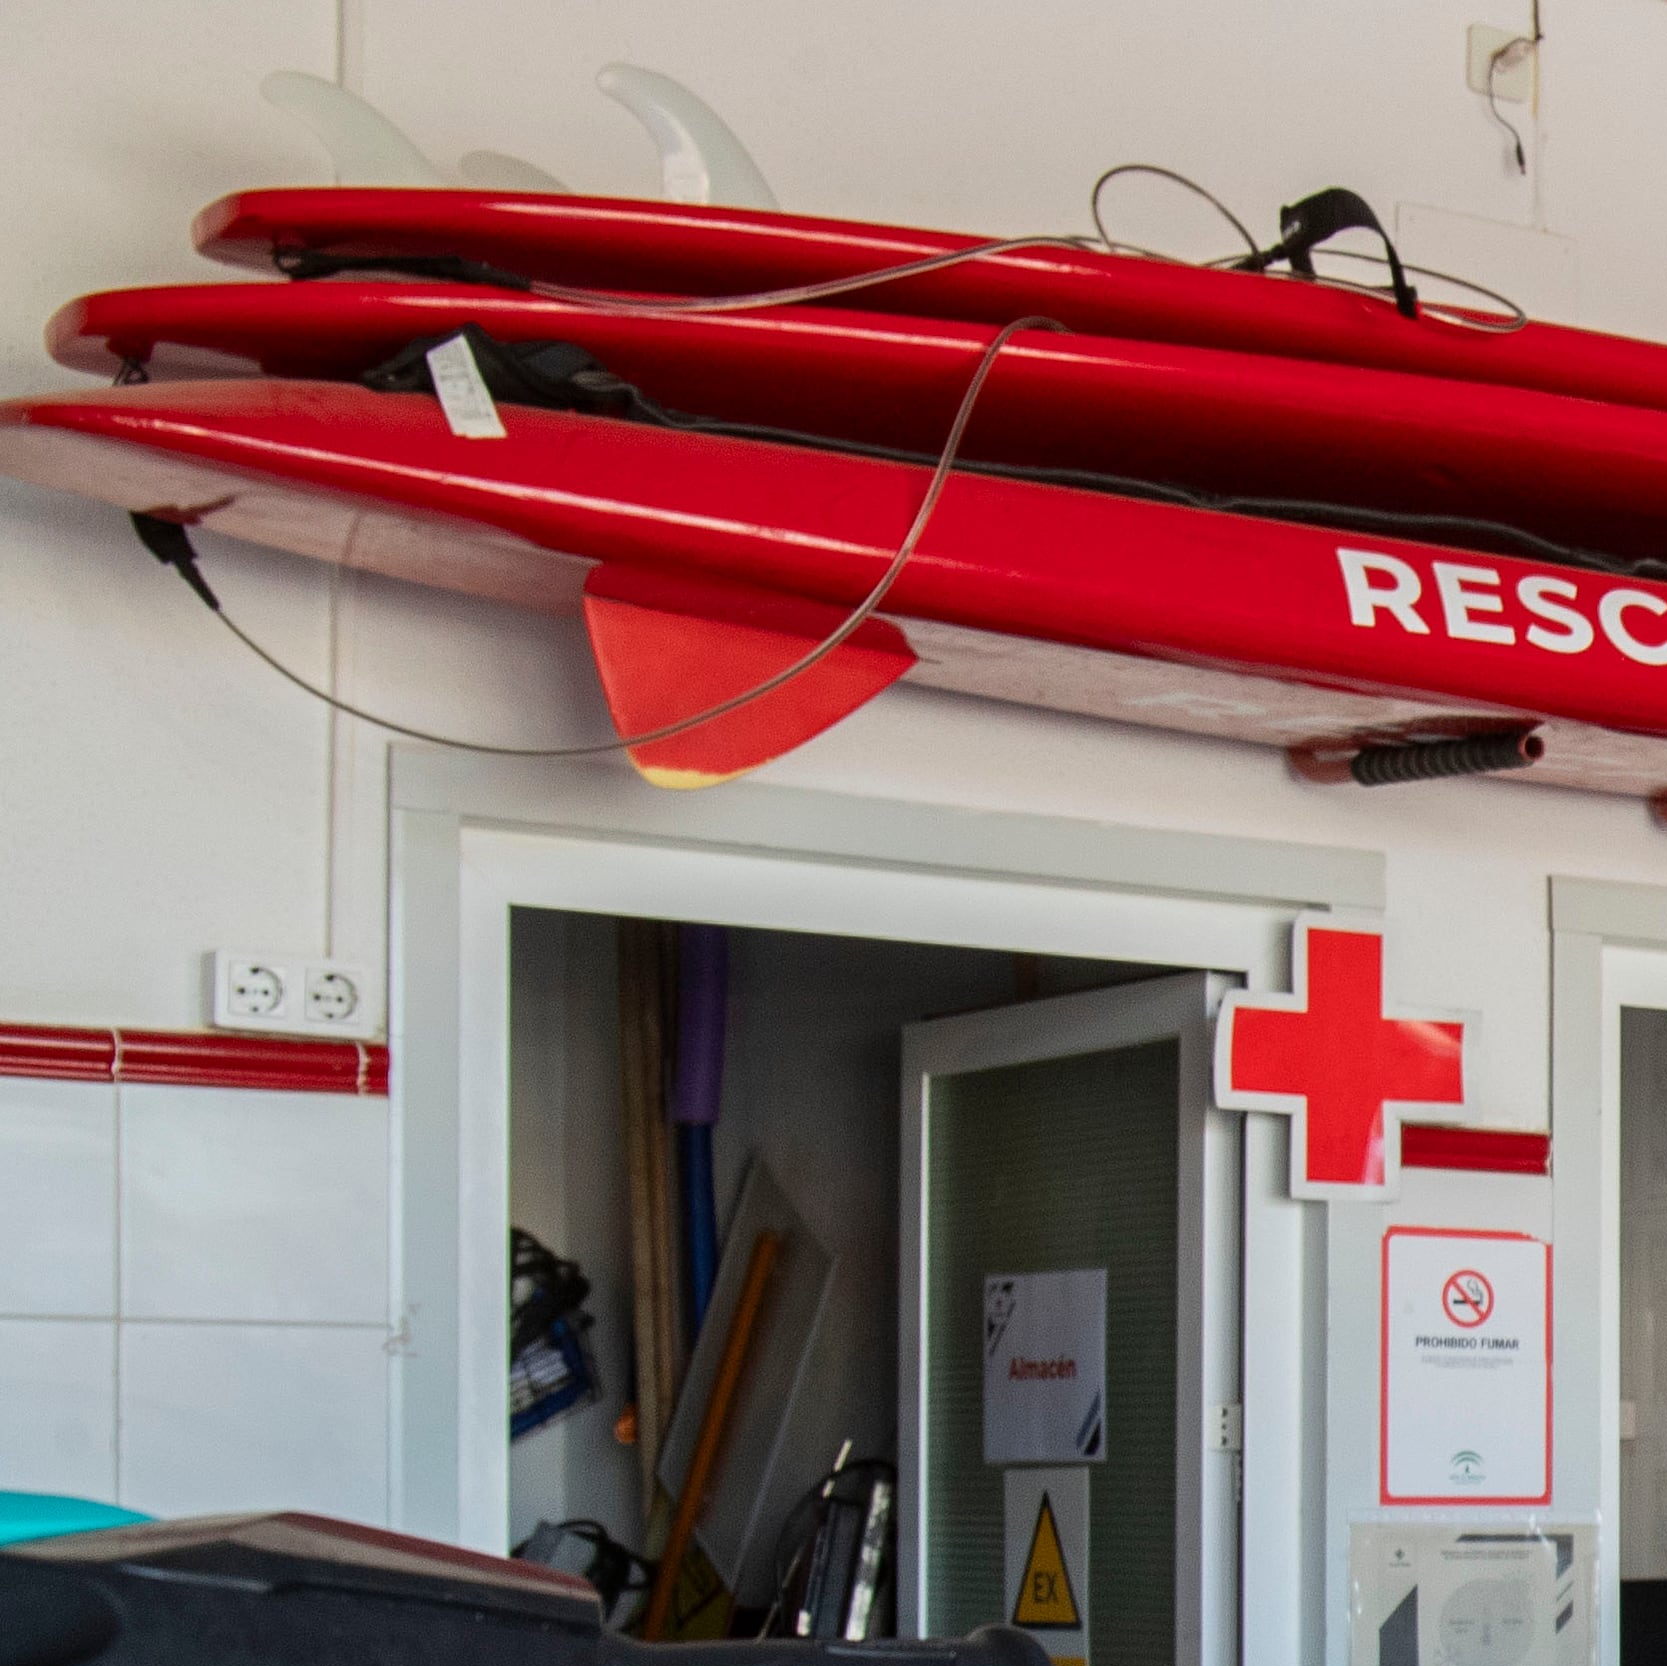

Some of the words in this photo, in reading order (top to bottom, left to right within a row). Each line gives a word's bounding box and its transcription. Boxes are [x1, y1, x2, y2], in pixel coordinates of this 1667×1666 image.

[1415, 1335, 1477, 1350] PROHIBIDO
[1481, 1337, 1520, 1351] FUMAR
[1008, 1354, 1078, 1381] Almacén
[1032, 1571, 1059, 1605] EX
